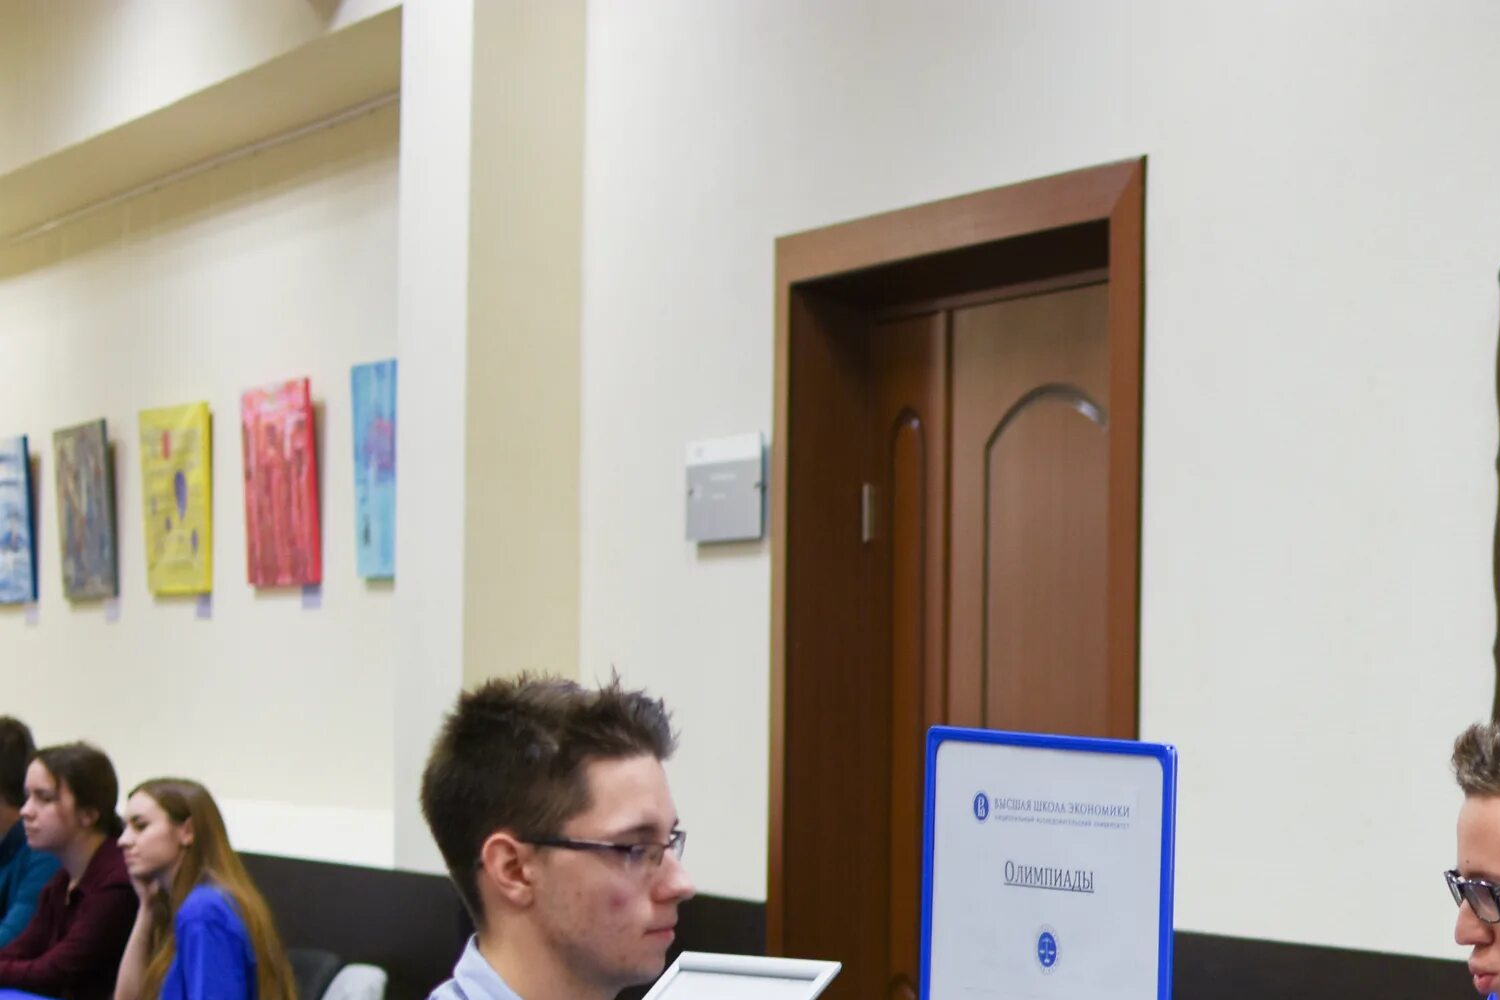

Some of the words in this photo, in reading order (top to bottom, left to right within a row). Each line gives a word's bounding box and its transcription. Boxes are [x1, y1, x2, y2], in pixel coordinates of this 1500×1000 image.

[994, 798, 1031, 811] ВЫСШАЯ
[1034, 799, 1065, 813] ШКОЛА
[1069, 802, 1130, 817] ЭКОНОМИКИ
